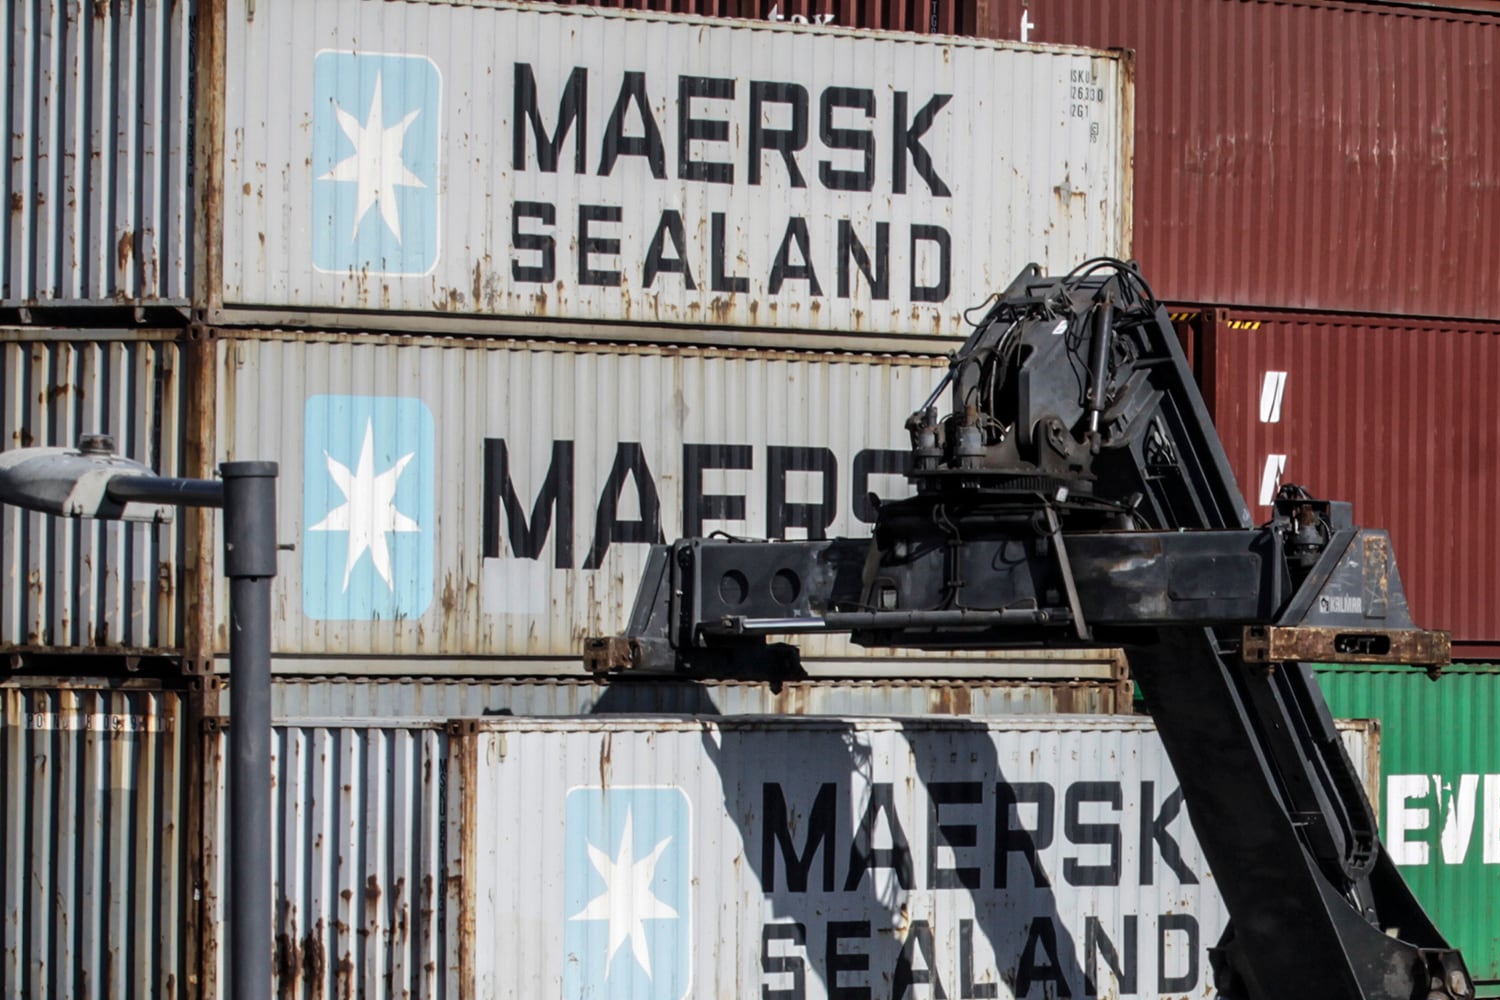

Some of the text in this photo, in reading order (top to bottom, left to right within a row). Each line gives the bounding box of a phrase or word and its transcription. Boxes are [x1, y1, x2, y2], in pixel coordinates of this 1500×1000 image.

[513, 62, 953, 197] MAERSK
[512, 201, 951, 301] SEALAND
[483, 438, 916, 569] MAERS
[761, 781, 1200, 893] MAERSK
